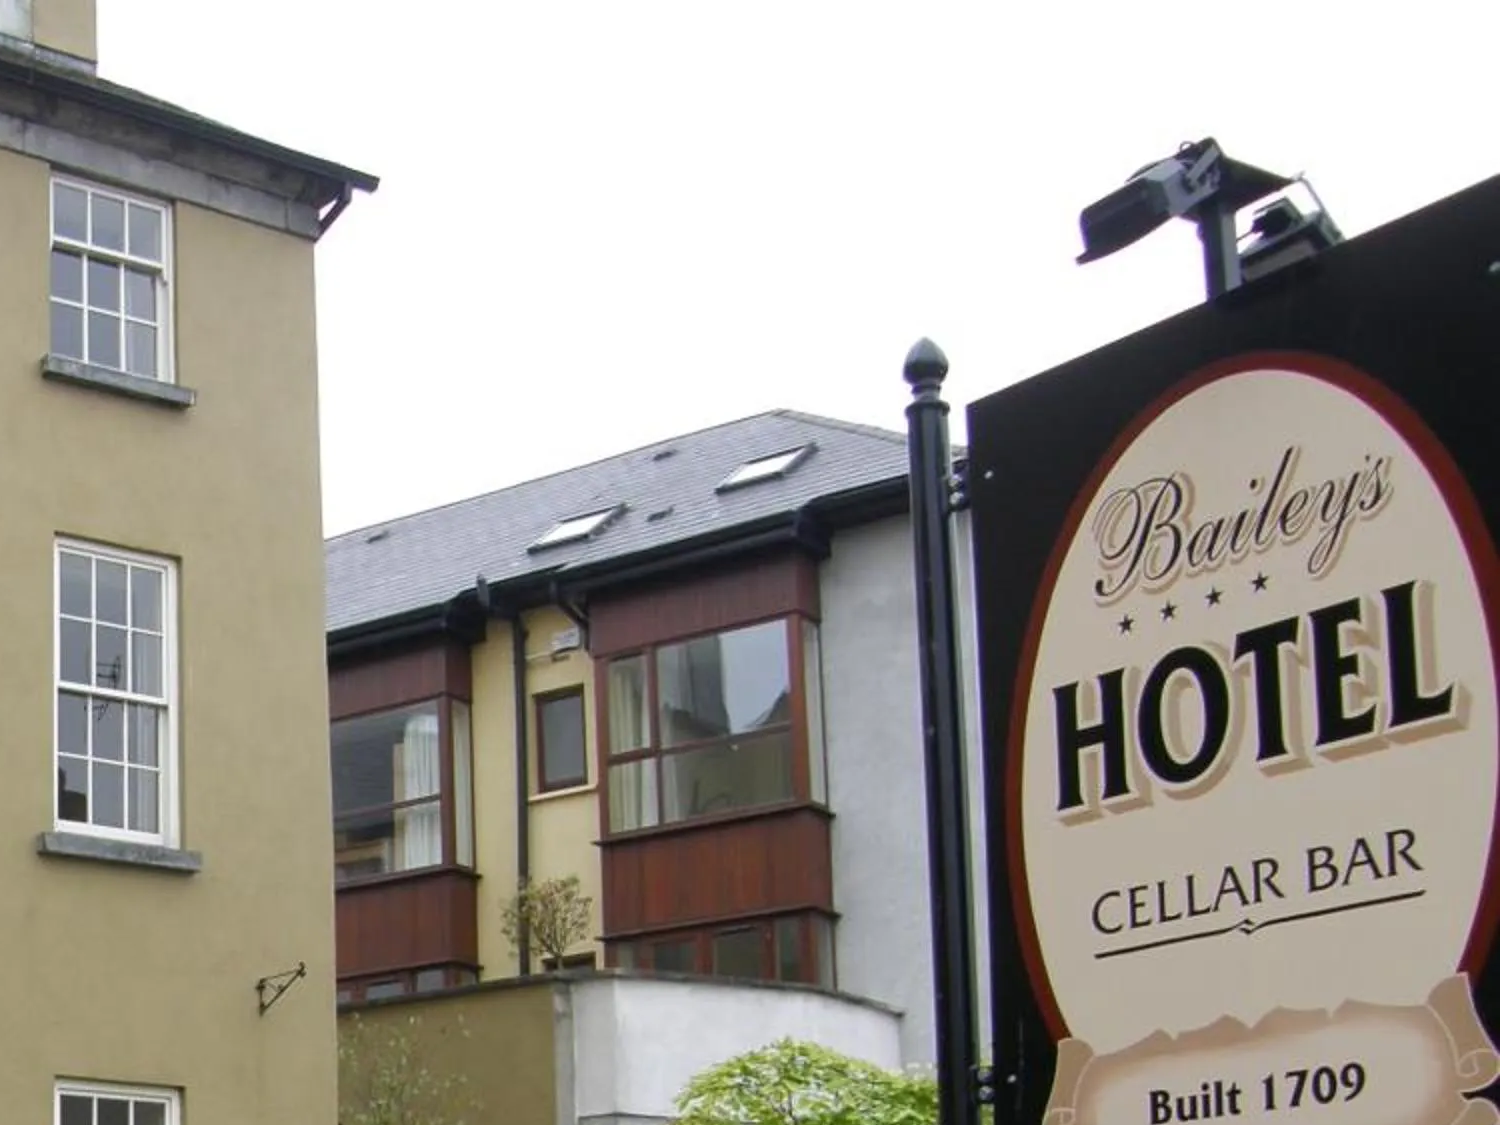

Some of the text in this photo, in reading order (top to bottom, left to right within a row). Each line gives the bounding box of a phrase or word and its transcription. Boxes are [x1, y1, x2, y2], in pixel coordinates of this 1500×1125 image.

[1091, 445, 1386, 598] Bailey's
[1052, 580, 1455, 813] HOTEL
[1091, 828, 1424, 935] CELLAR BAR
[1148, 1062, 1367, 1125] Built 1709
